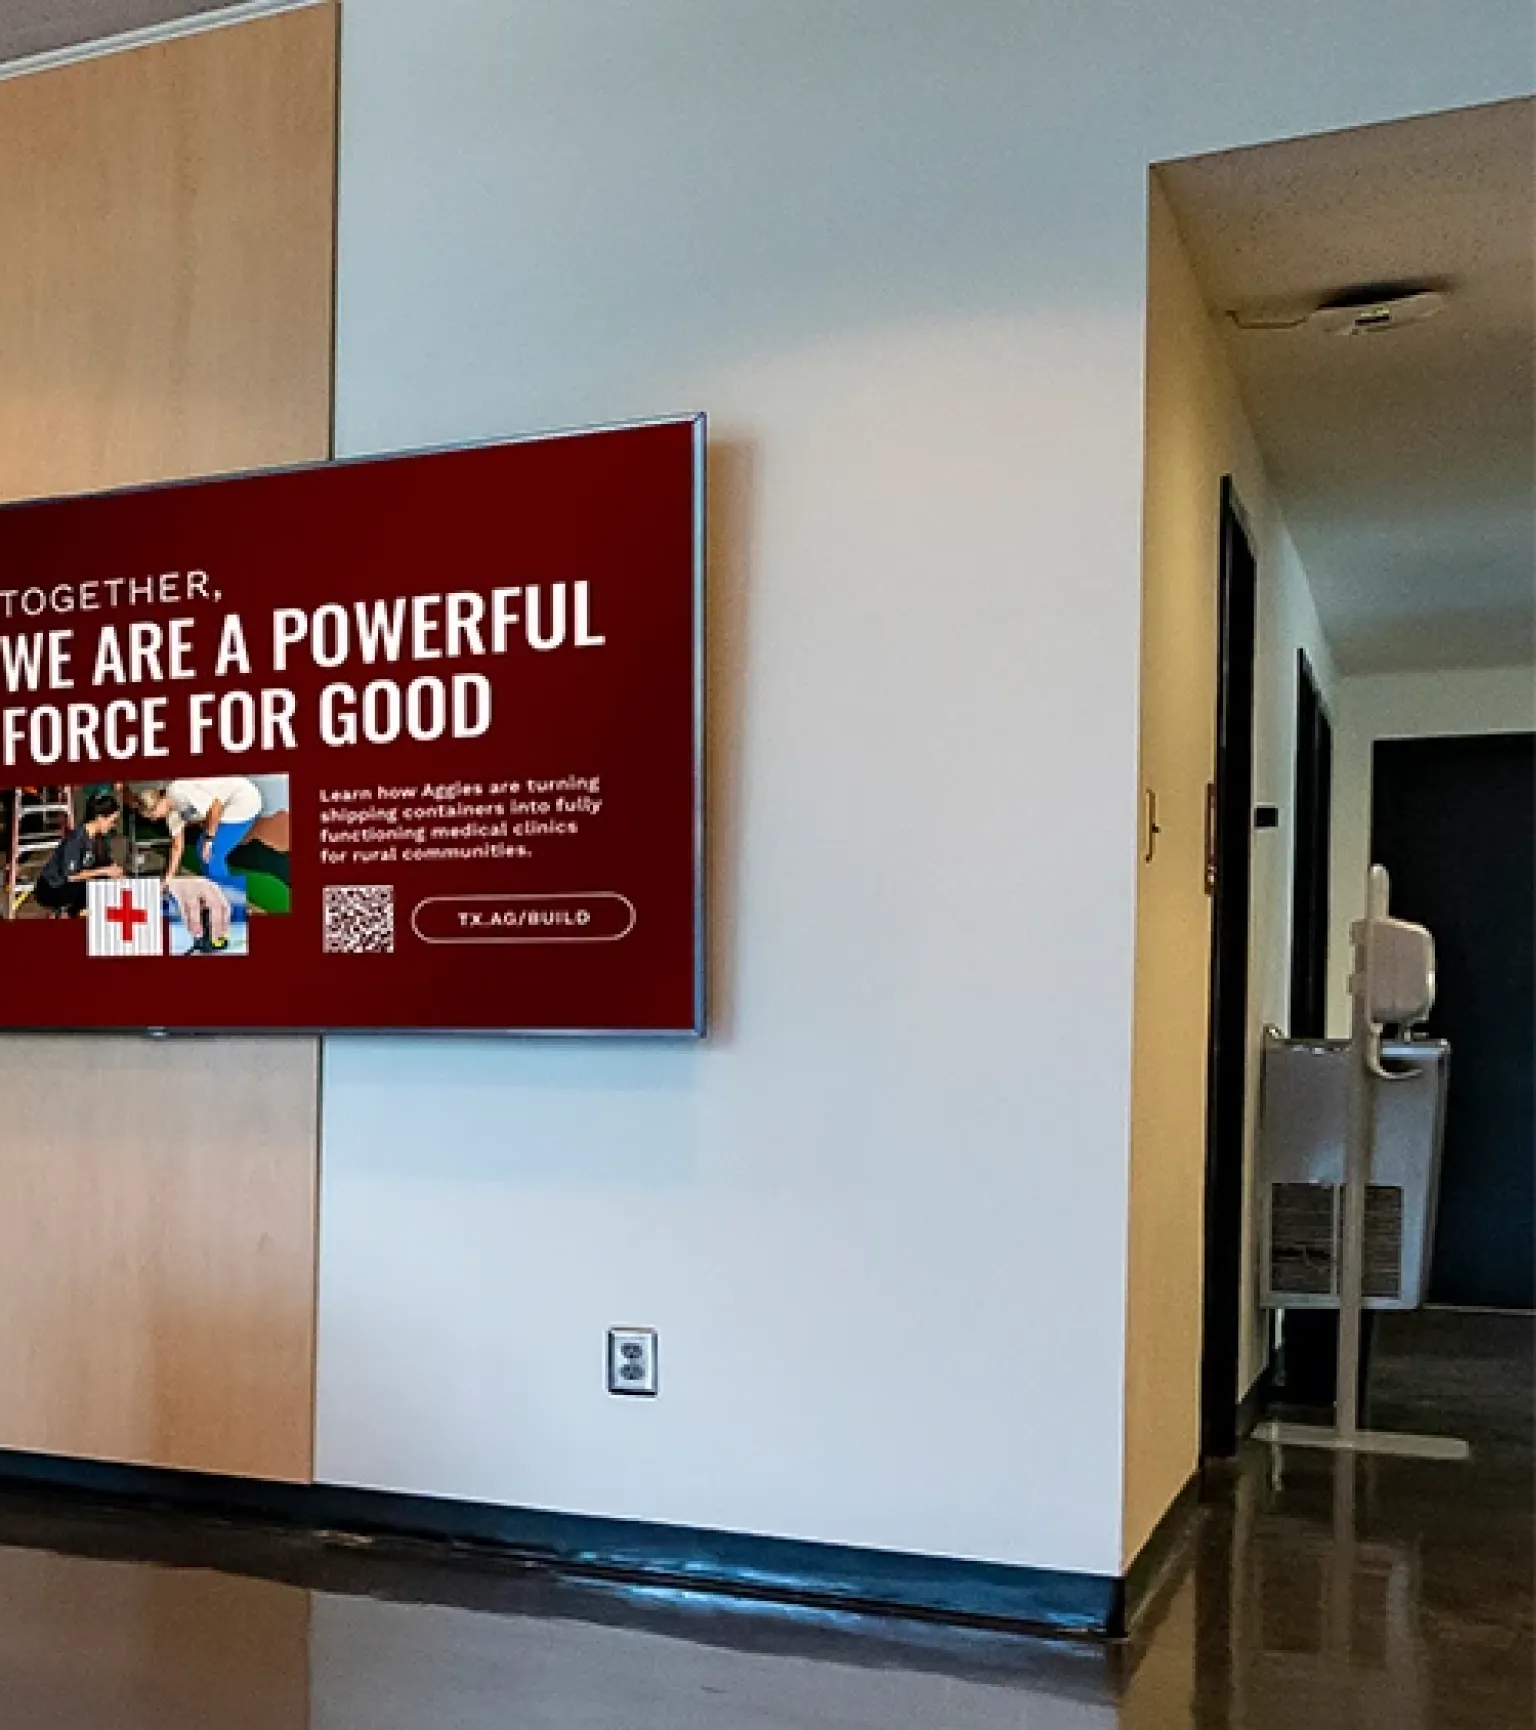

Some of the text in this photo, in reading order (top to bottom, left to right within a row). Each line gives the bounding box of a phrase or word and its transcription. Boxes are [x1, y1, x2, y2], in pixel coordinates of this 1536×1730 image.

[0, 580, 606, 693] WE ARE A POWERFUL
[2, 672, 493, 766] FORCE FOR GOOD
[319, 774, 600, 803] Learn how Aggies are turning
[319, 796, 603, 824] shipping containers into fully
[319, 819, 579, 844] functioning medical clinics
[319, 842, 533, 864] for rural communities.
[458, 910, 591, 928] TX.AG/BUILD
